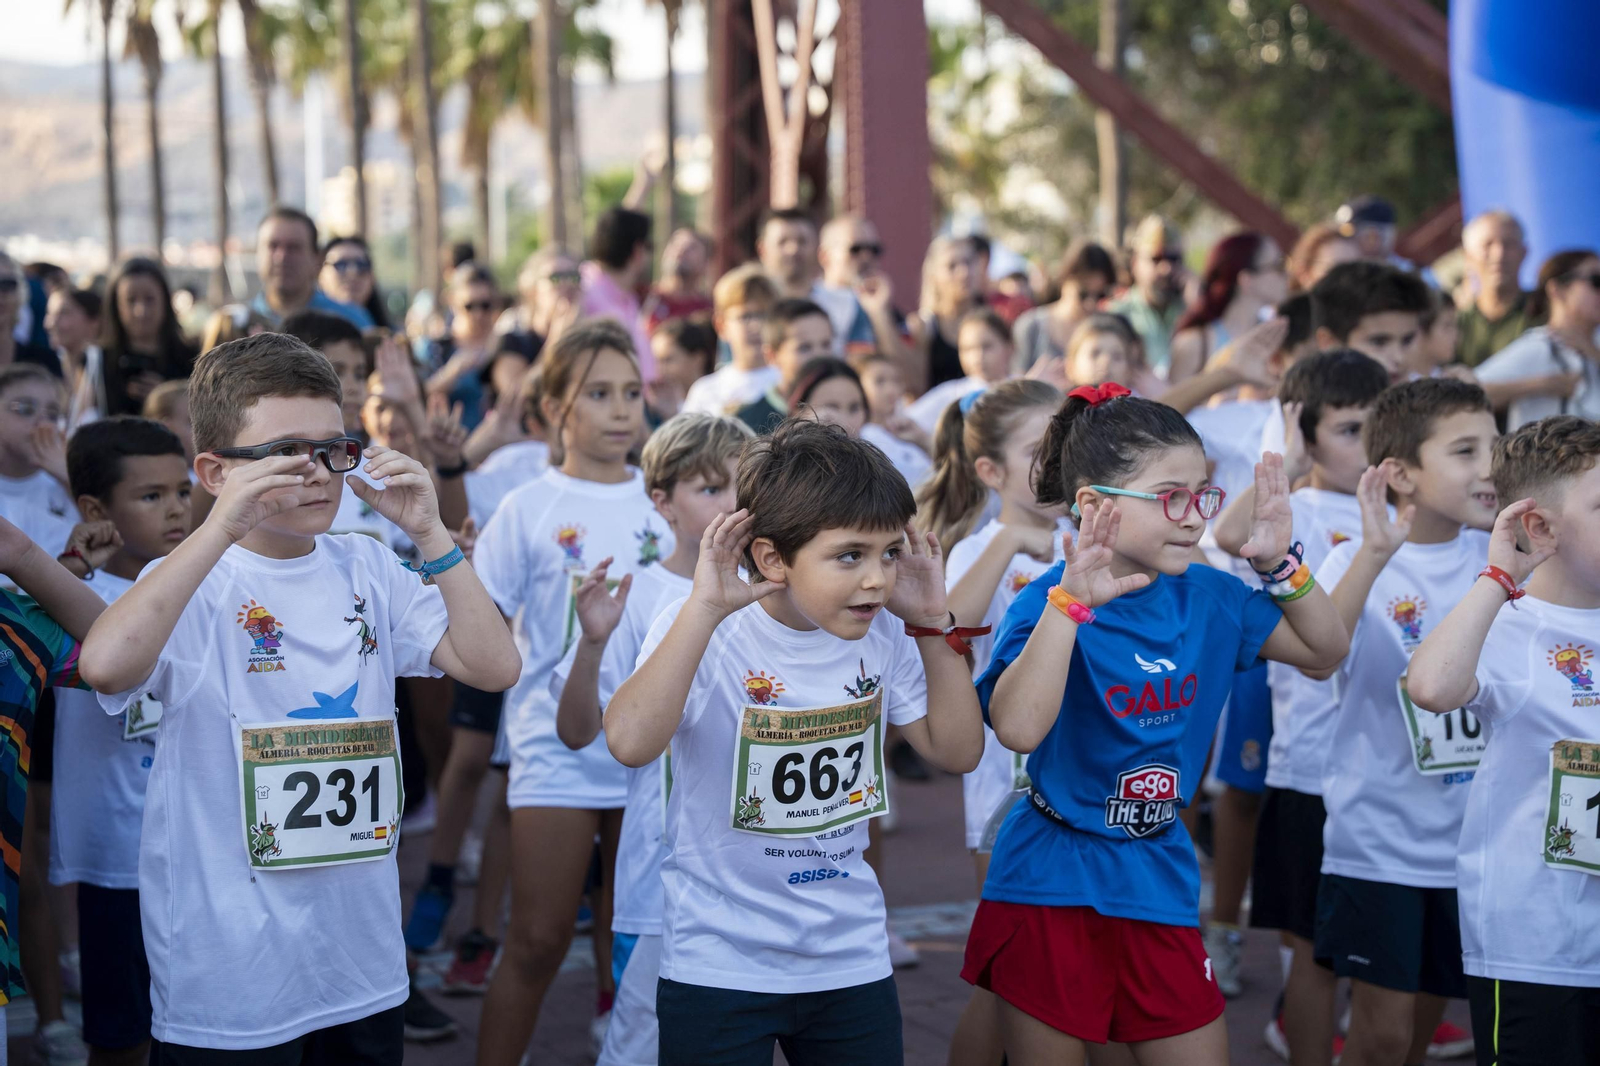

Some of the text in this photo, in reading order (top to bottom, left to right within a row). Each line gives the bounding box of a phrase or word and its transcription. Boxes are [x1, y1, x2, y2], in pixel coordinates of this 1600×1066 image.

[247, 660, 286, 673] AIDA
[1104, 673, 1198, 719] GALO
[750, 712, 770, 729] LA
[1138, 713, 1175, 728] SPORT
[799, 727, 836, 739] ROQUETAS
[252, 733, 273, 749] LA
[258, 746, 300, 759] ALMERÍA
[307, 744, 351, 756] ROQUETAS
[352, 744, 361, 753] DE
[772, 741, 864, 805] 663
[1566, 761, 1600, 773] ALMERÍ
[1130, 773, 1170, 798] ego
[283, 765, 379, 830] 231
[786, 808, 820, 818] MANUEL
[1109, 800, 1143, 824] THE
[350, 830, 374, 841] MIGUEL
[764, 847, 785, 857] SER
[788, 868, 839, 885] asisa
